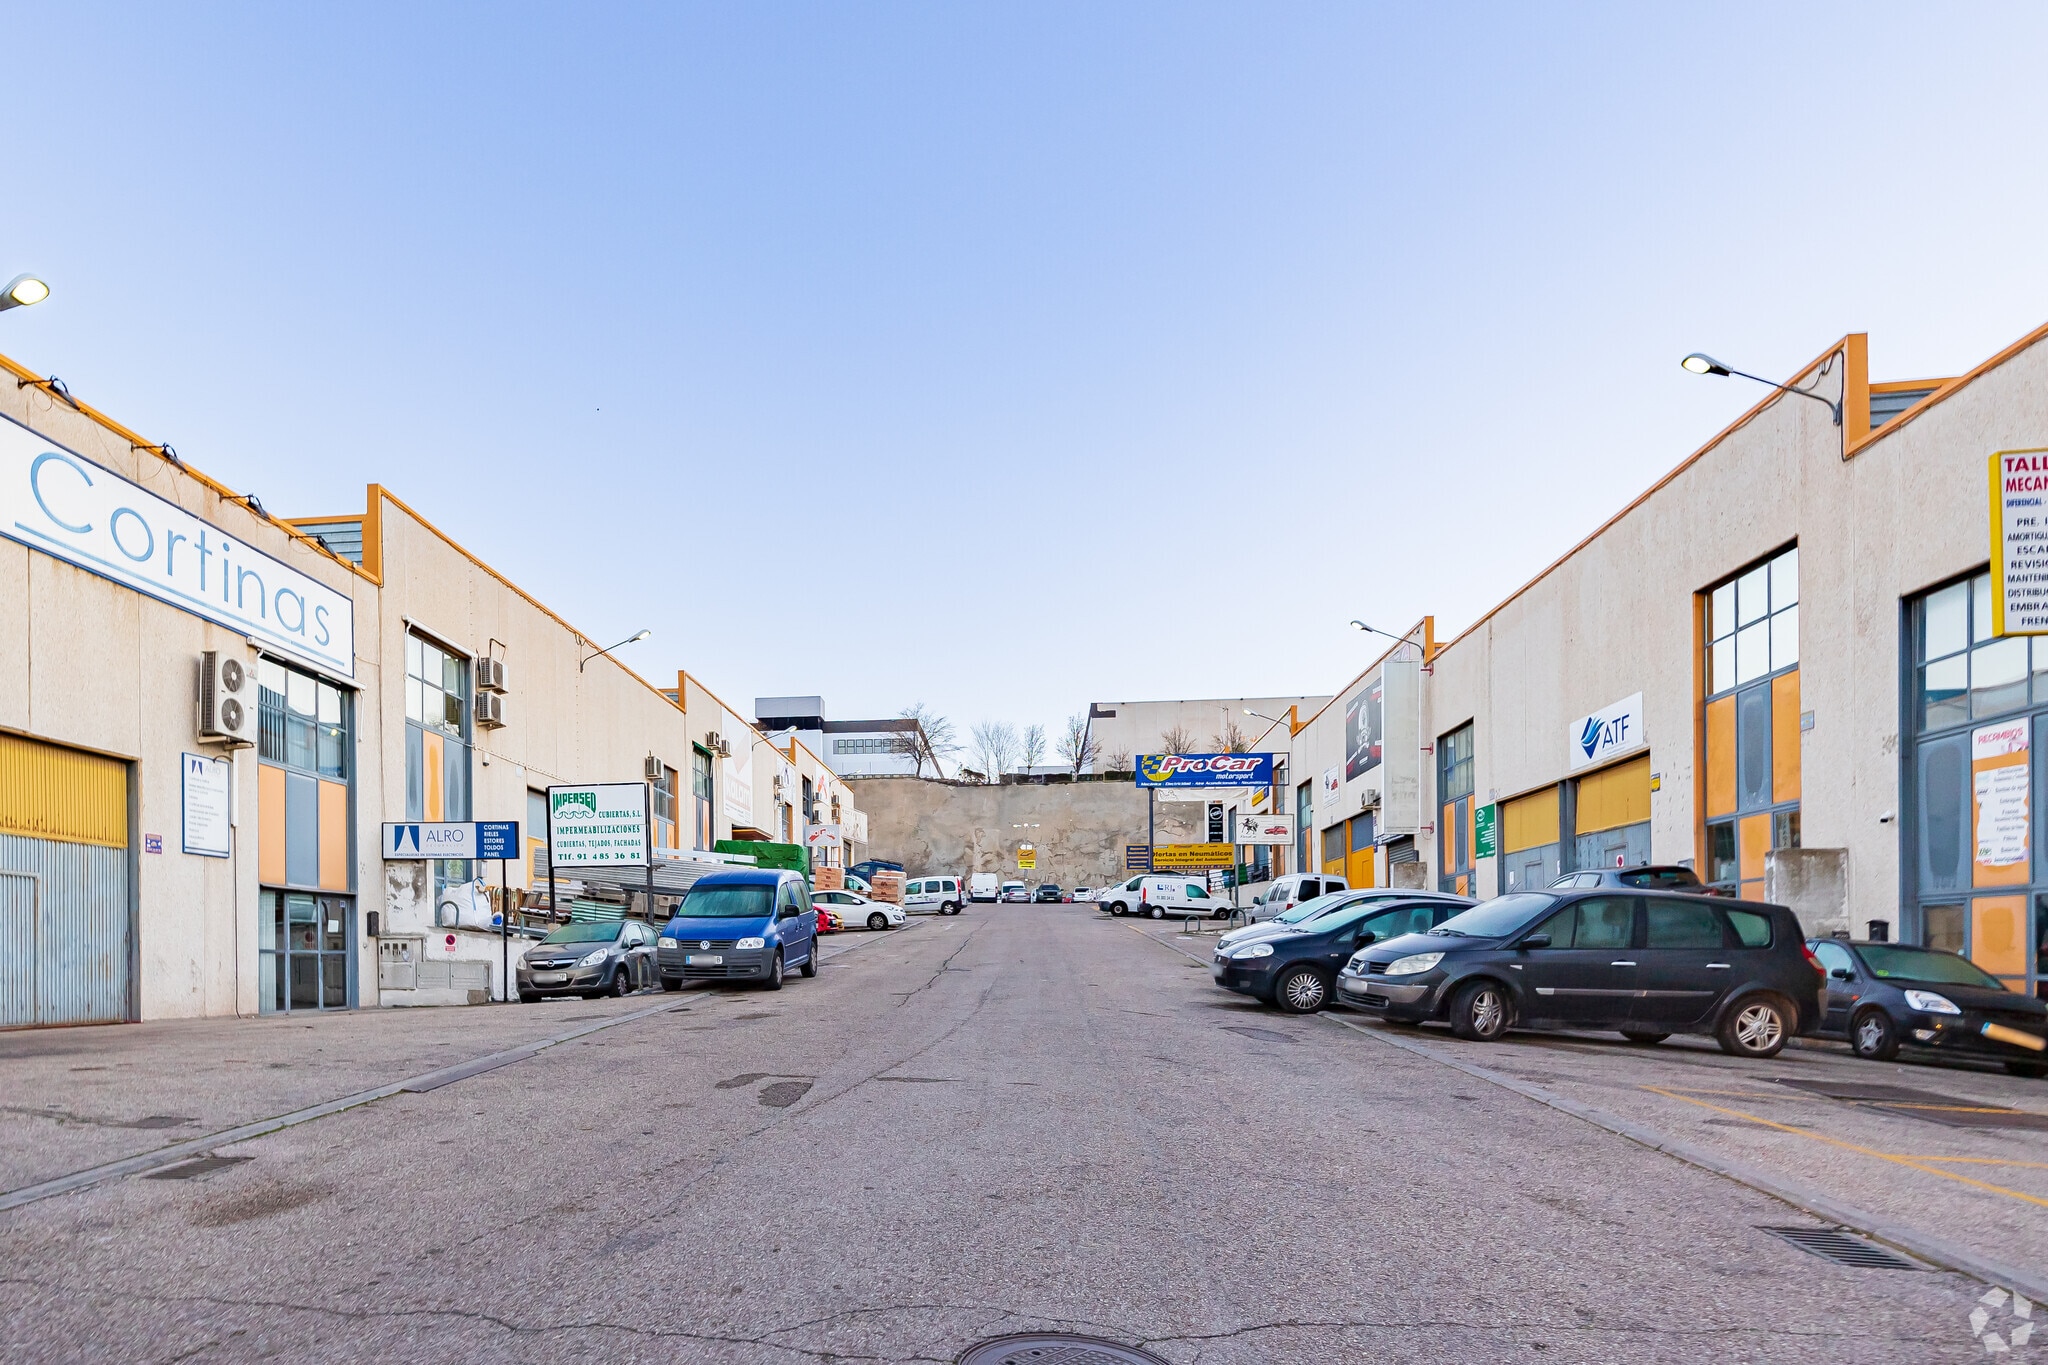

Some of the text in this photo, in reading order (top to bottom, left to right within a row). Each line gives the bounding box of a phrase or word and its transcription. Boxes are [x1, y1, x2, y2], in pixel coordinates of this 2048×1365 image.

[2005, 455, 2048, 474] TALL
[30, 451, 330, 647] Cortinas
[2017, 545, 2048, 555] ESCA
[2007, 572, 2048, 583] MANTENI
[1602, 713, 1630, 749] ATF
[1978, 727, 2024, 744] RECAMBIOS
[1160, 756, 1263, 772] ProCar
[1216, 772, 1253, 780] motorsport
[426, 829, 464, 843] ALRO
[556, 825, 640, 835] IMPERMEABILIZACIONES
[613, 839, 641, 847] FACHADAS
